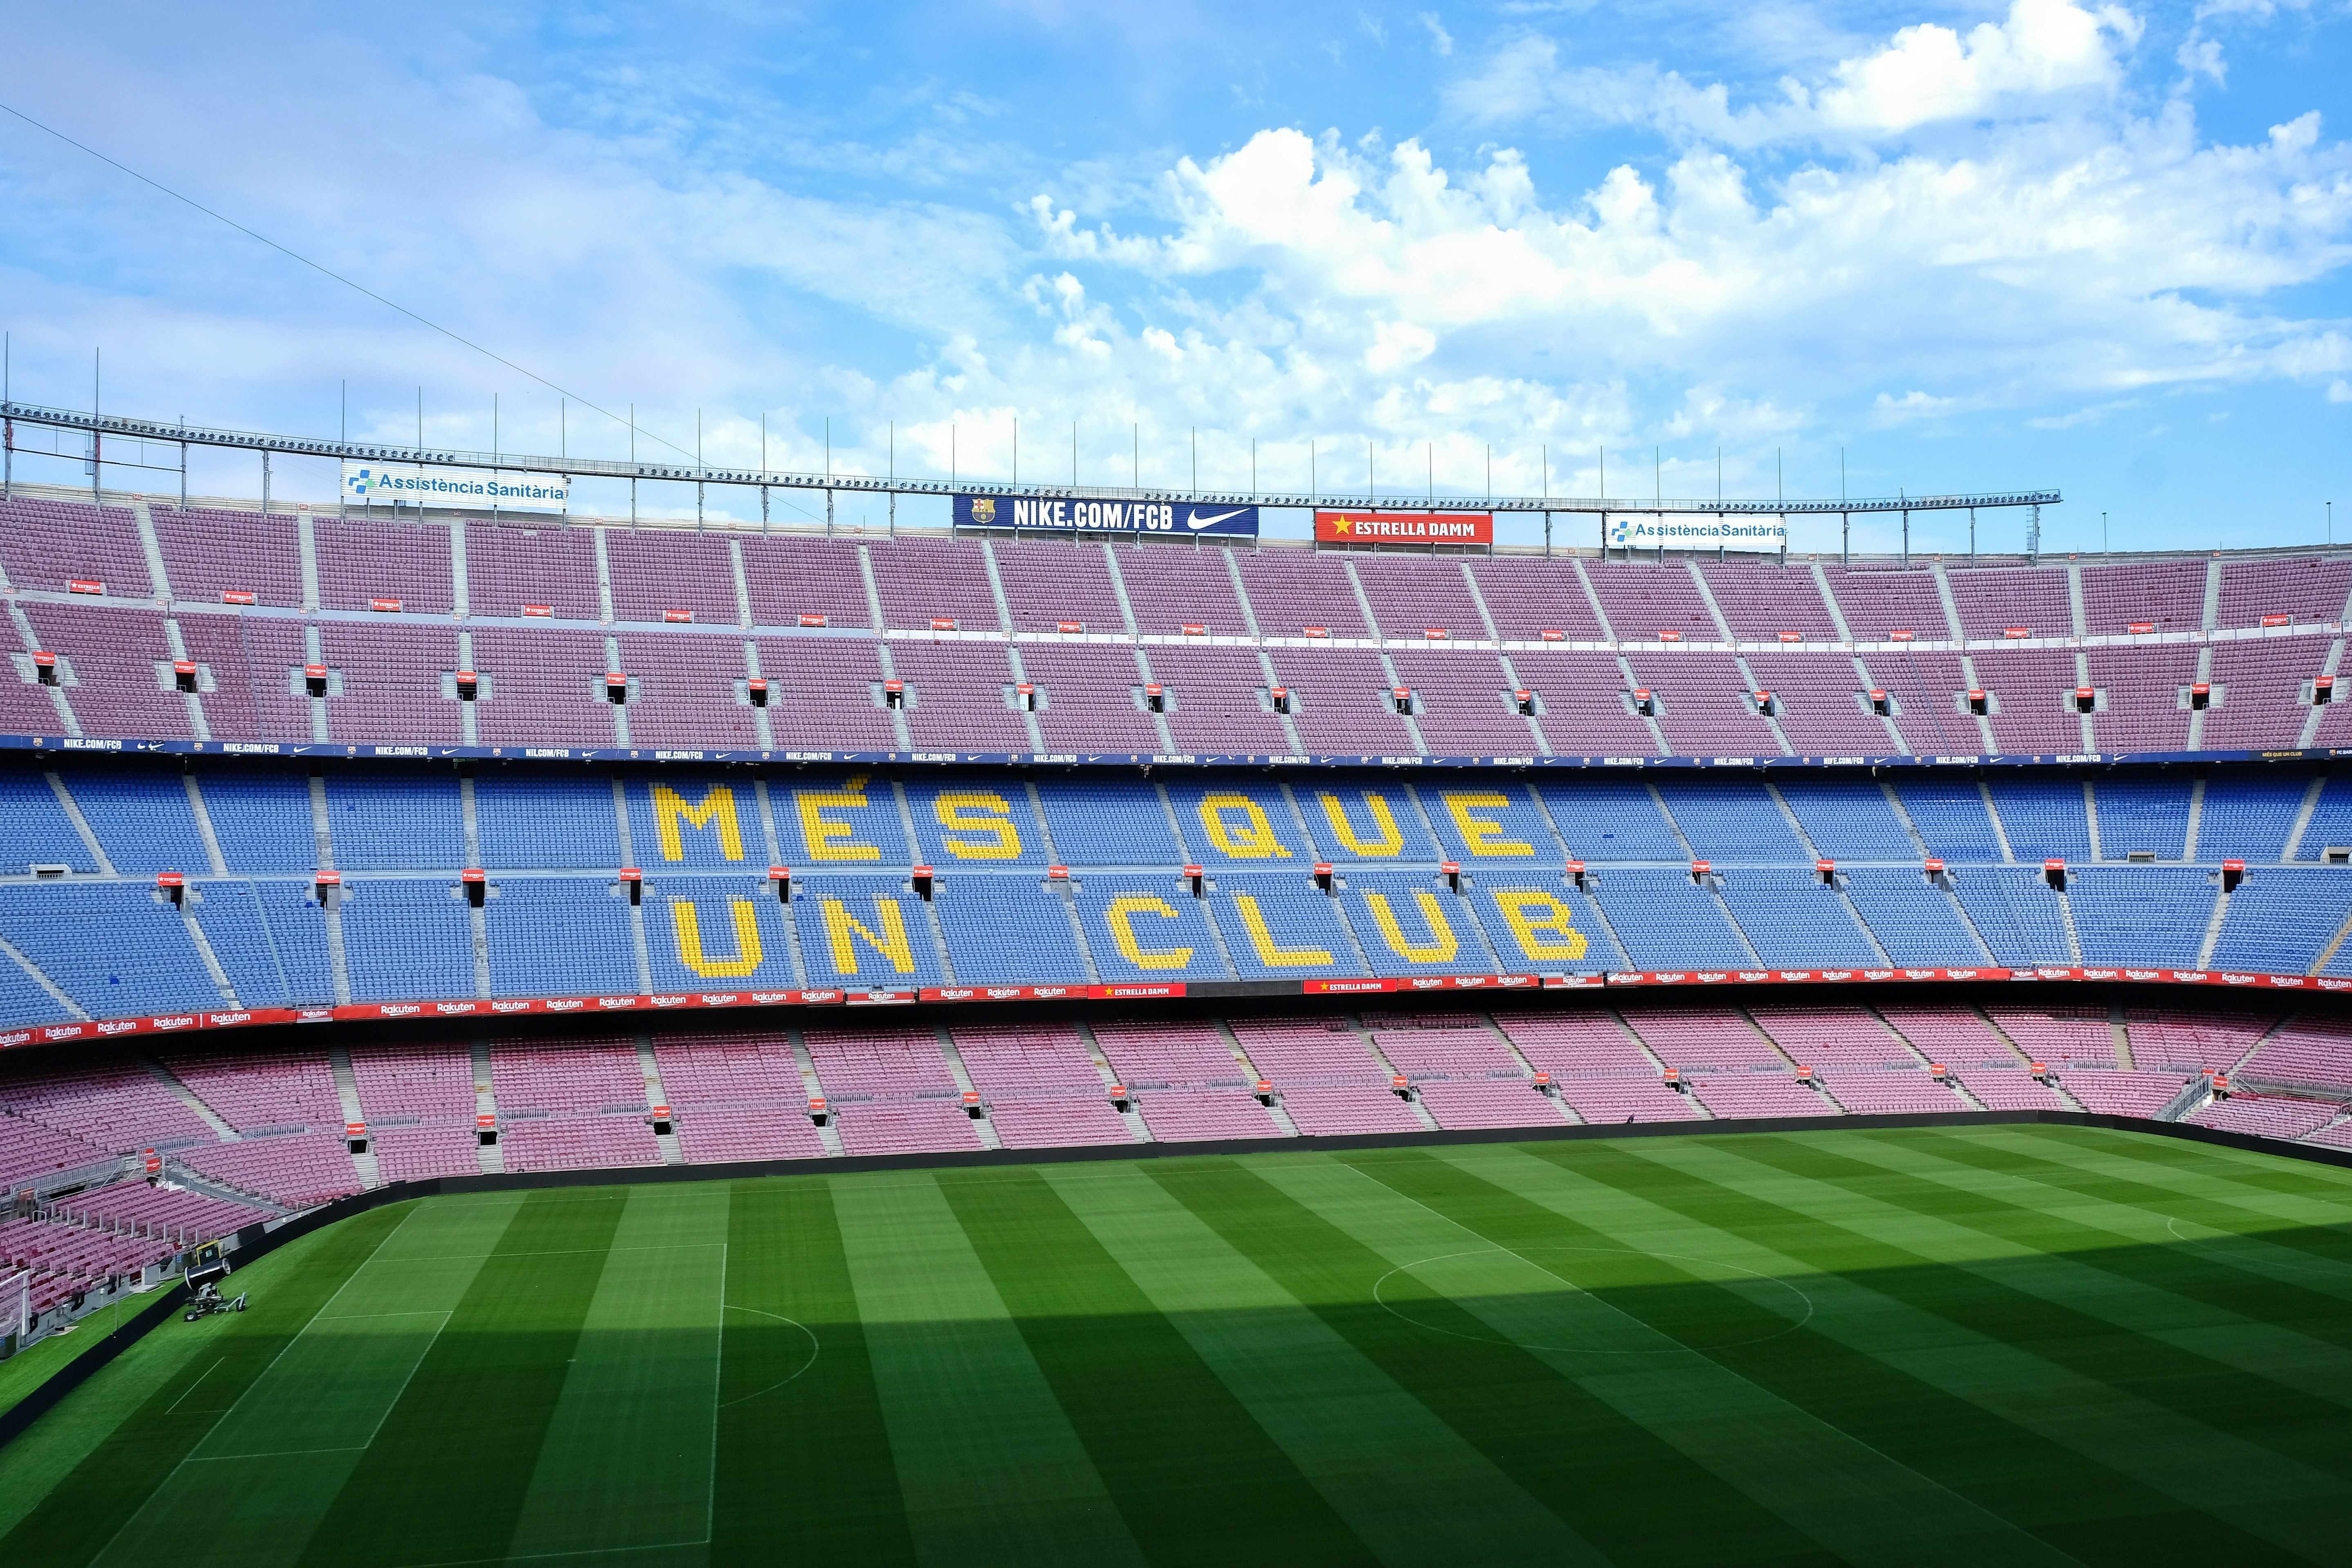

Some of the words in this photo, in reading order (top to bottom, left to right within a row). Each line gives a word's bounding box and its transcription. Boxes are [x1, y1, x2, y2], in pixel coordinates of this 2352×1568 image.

[379, 474, 484, 494] Assistència
[487, 482, 564, 500] Sanitària
[1013, 499, 1173, 530] NIKE.COM/FCB
[1355, 522, 1426, 536] ESTRELLA
[1429, 523, 1475, 536] DAMM
[1635, 524, 1719, 536] Assistència
[1722, 524, 1785, 536] Sanitària
[64, 739, 122, 749] NIKE.COM/FCB
[223, 742, 279, 753] NIKE.COM/FCB
[375, 746, 428, 755] NIKE.COM/FCB
[655, 750, 703, 759] NIKE.COM/FCB
[786, 752, 832, 760] NIKE.COM/FCB
[1034, 754, 1077, 762] NIKE.COM/FCB
[2056, 755, 2101, 763] NIKE.COM/FCB
[655, 774, 1022, 860] MÉS
[1200, 794, 1534, 858] QUE
[674, 900, 915, 977] UN
[1107, 892, 1588, 969] CLUB
[1656, 972, 1685, 981] Rakuten
[1698, 972, 1726, 980] Rakuten
[1740, 971, 1768, 979] Rakuten
[1781, 971, 1810, 979] Rakuten
[1822, 970, 1851, 979] Rakuten
[1864, 970, 1893, 978] Rakuten
[1906, 969, 1935, 977] Rakuten
[1947, 969, 1976, 977] Rakuten
[2038, 968, 2070, 977] Rakuten
[2084, 969, 2116, 977] Rakuten
[2126, 970, 2159, 978] Rakuten
[2173, 971, 2207, 980] Rakuten
[1413, 978, 1443, 986] Rakuten
[1455, 977, 1485, 985] Rakuten
[2222, 974, 2255, 983] Rakuten
[2271, 976, 2303, 985] Rakuten
[2318, 979, 2352, 988] Rakuten
[801, 990, 835, 999] Rakuten
[941, 989, 973, 997] Rakuten
[1034, 987, 1066, 995] Rakuten
[651, 995, 686, 1004] Rakuten
[702, 994, 737, 1003] Rakuten
[752, 992, 786, 1001] Rakuten
[492, 1001, 529, 1010] Rakuten
[547, 999, 583, 1008] Rakuten
[599, 997, 635, 1006] Rakuten
[381, 1004, 420, 1014] Rakuten
[437, 1002, 475, 1011] Rakuten
[154, 1017, 193, 1027] Rakuten
[211, 1013, 251, 1023] Rakuten
[98, 1021, 136, 1032] Rakuten
[46, 1026, 81, 1037] Rakuten
